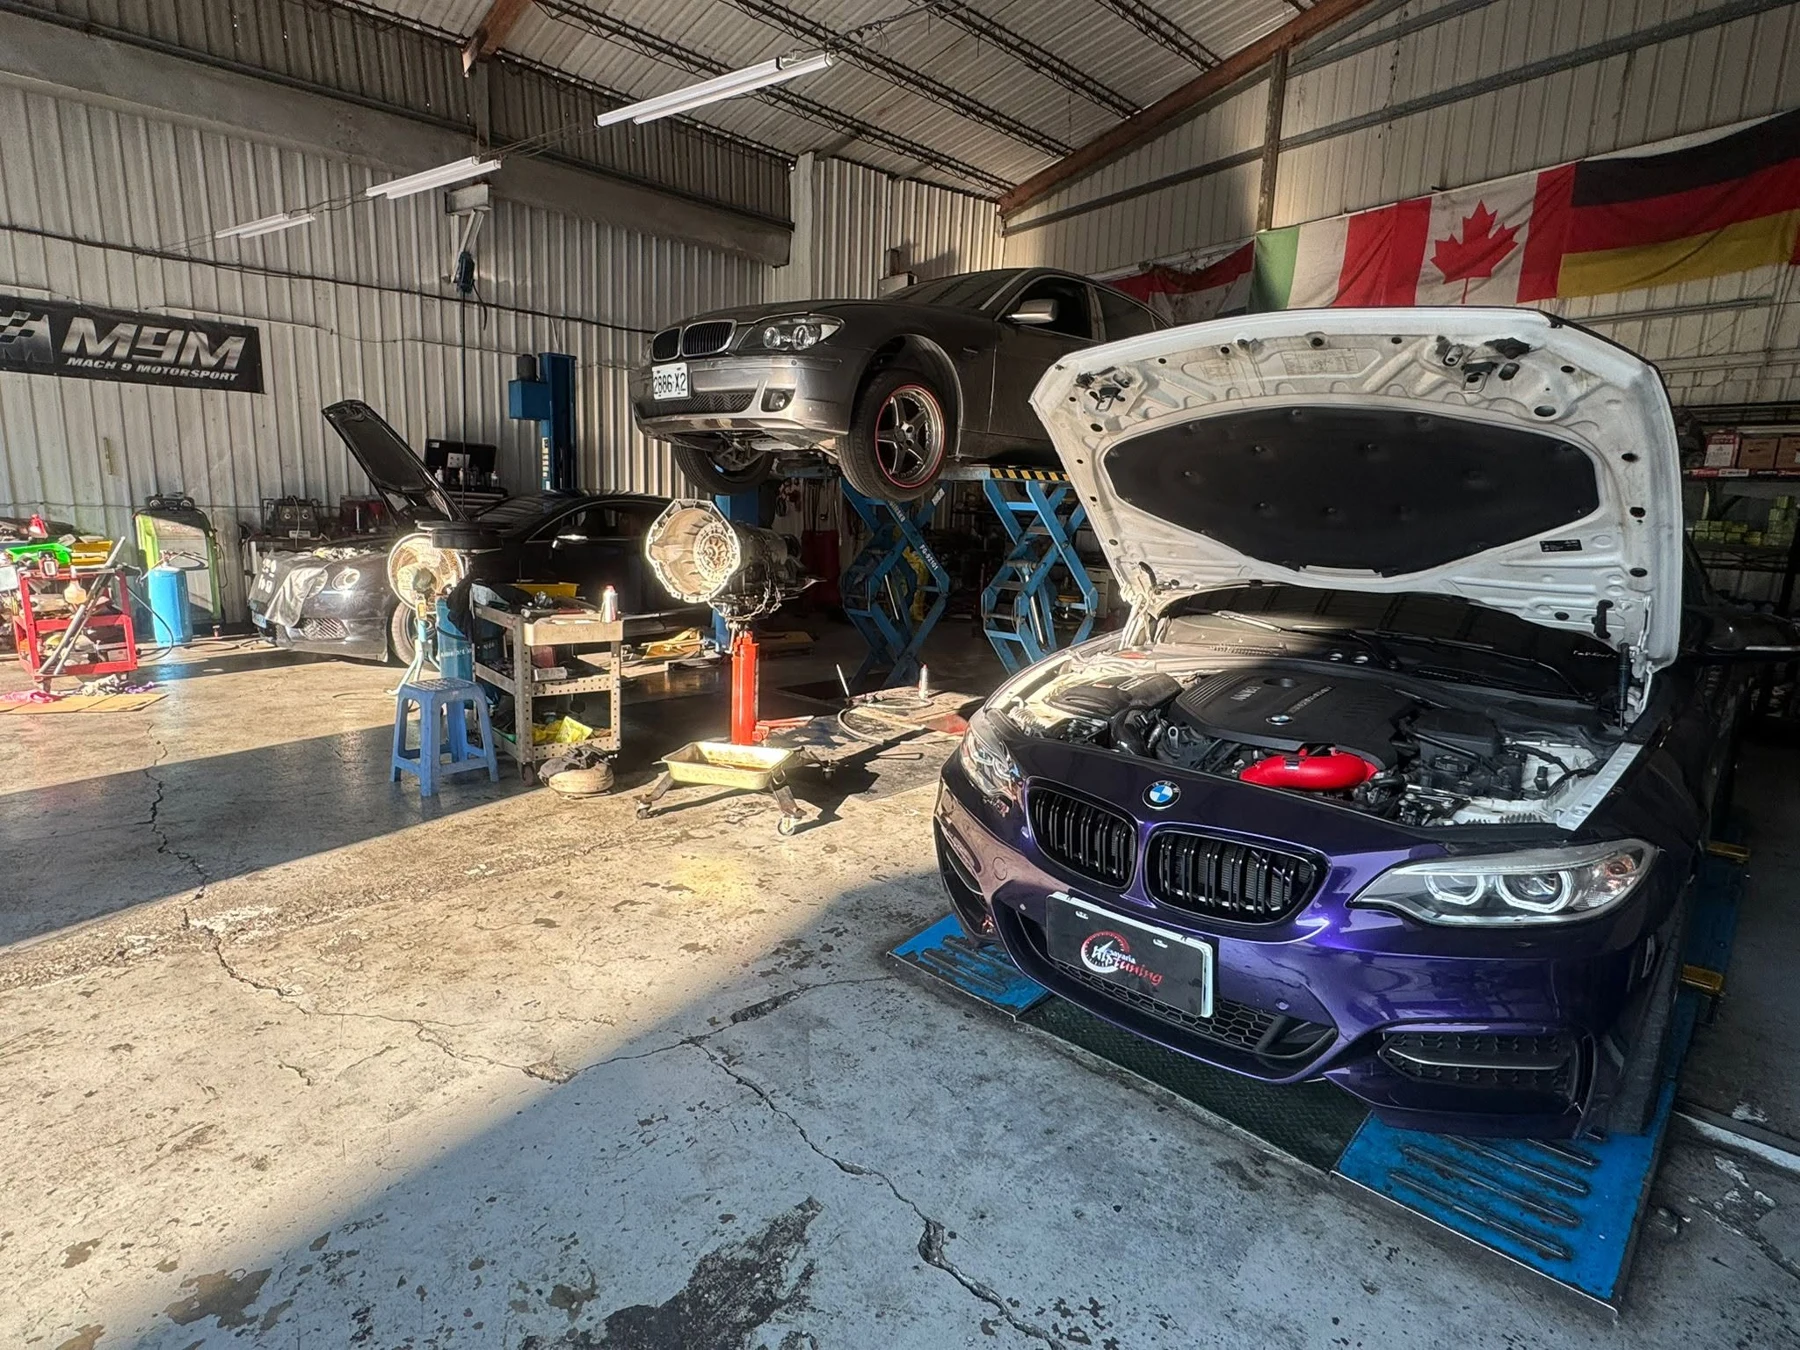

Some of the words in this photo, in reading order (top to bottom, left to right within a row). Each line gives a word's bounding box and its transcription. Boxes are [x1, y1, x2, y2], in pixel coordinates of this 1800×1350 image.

[61, 316, 246, 370] M9M
[66, 357, 118, 370] MACH
[120, 363, 132, 372] 9
[136, 364, 239, 382] MOTORSPORT
